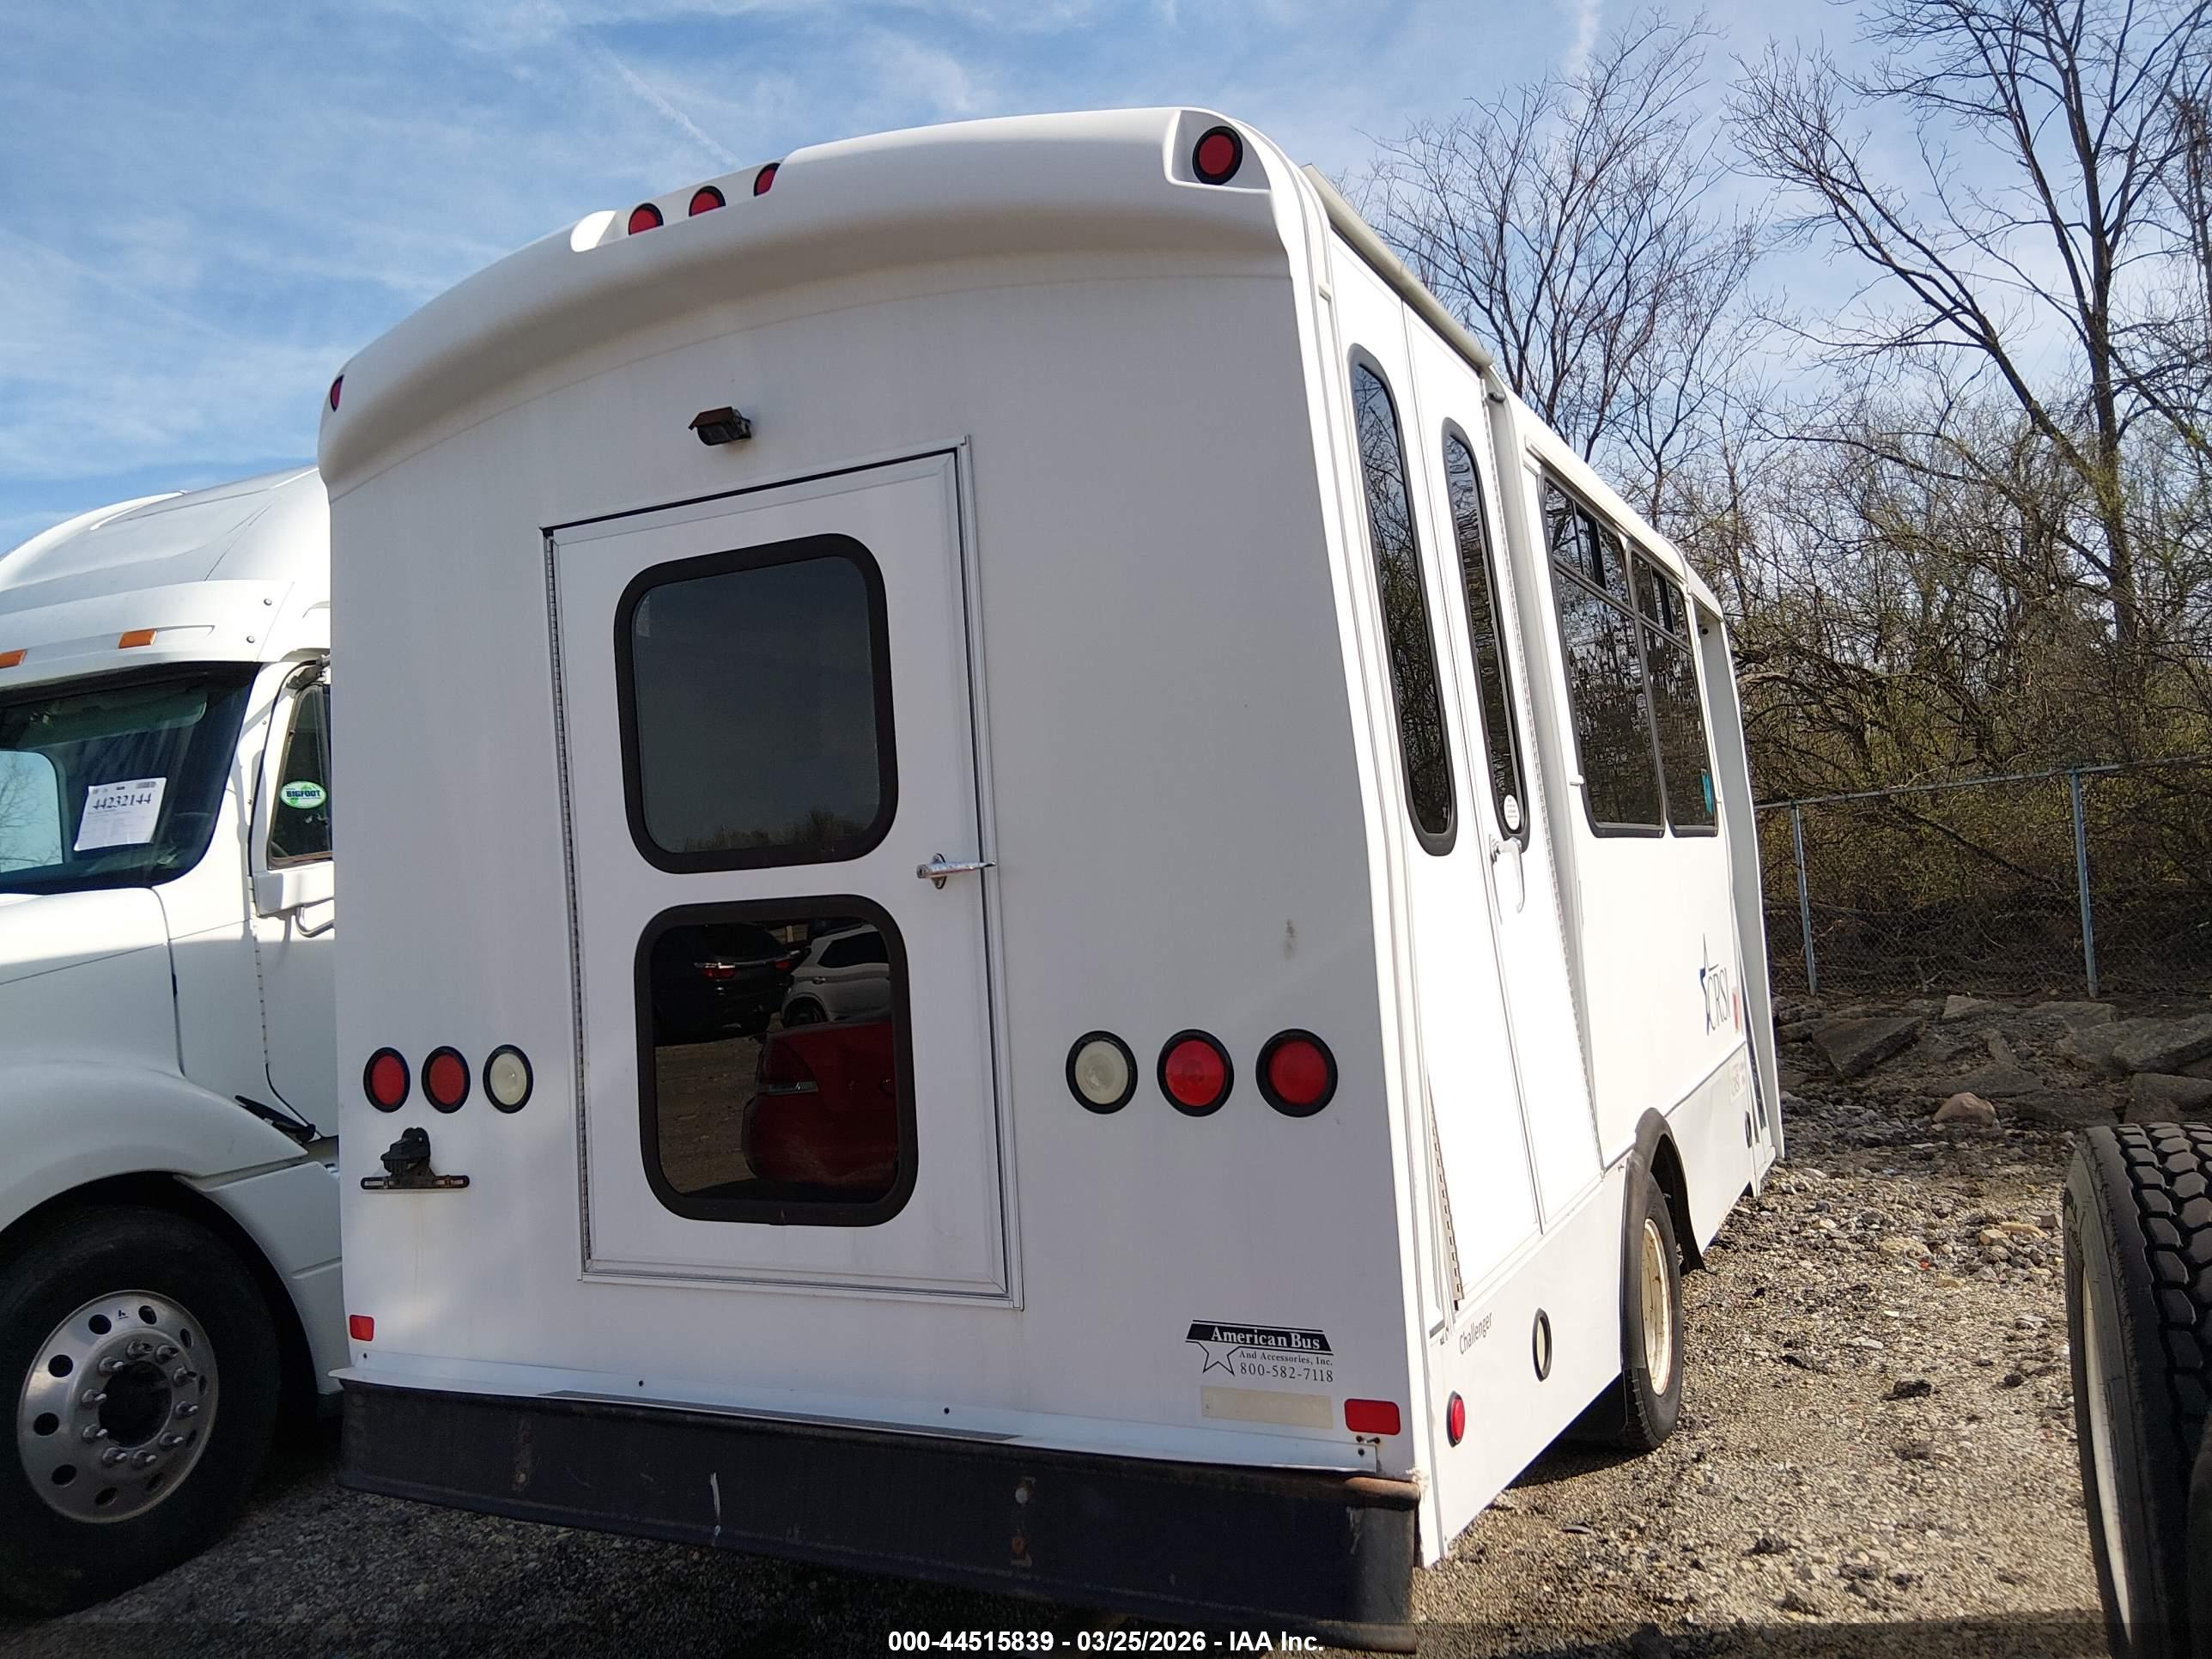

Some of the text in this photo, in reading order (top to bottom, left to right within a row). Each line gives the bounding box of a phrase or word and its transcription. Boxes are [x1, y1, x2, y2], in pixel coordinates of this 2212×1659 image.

[93, 793, 152, 810] 44232144
[1211, 1326, 1321, 1350] American Bus
[1459, 1311, 1492, 1355] Challenger
[1239, 1350, 1334, 1366] And Accessories, Inc.
[1240, 1362, 1334, 1382] 800-582-7118
